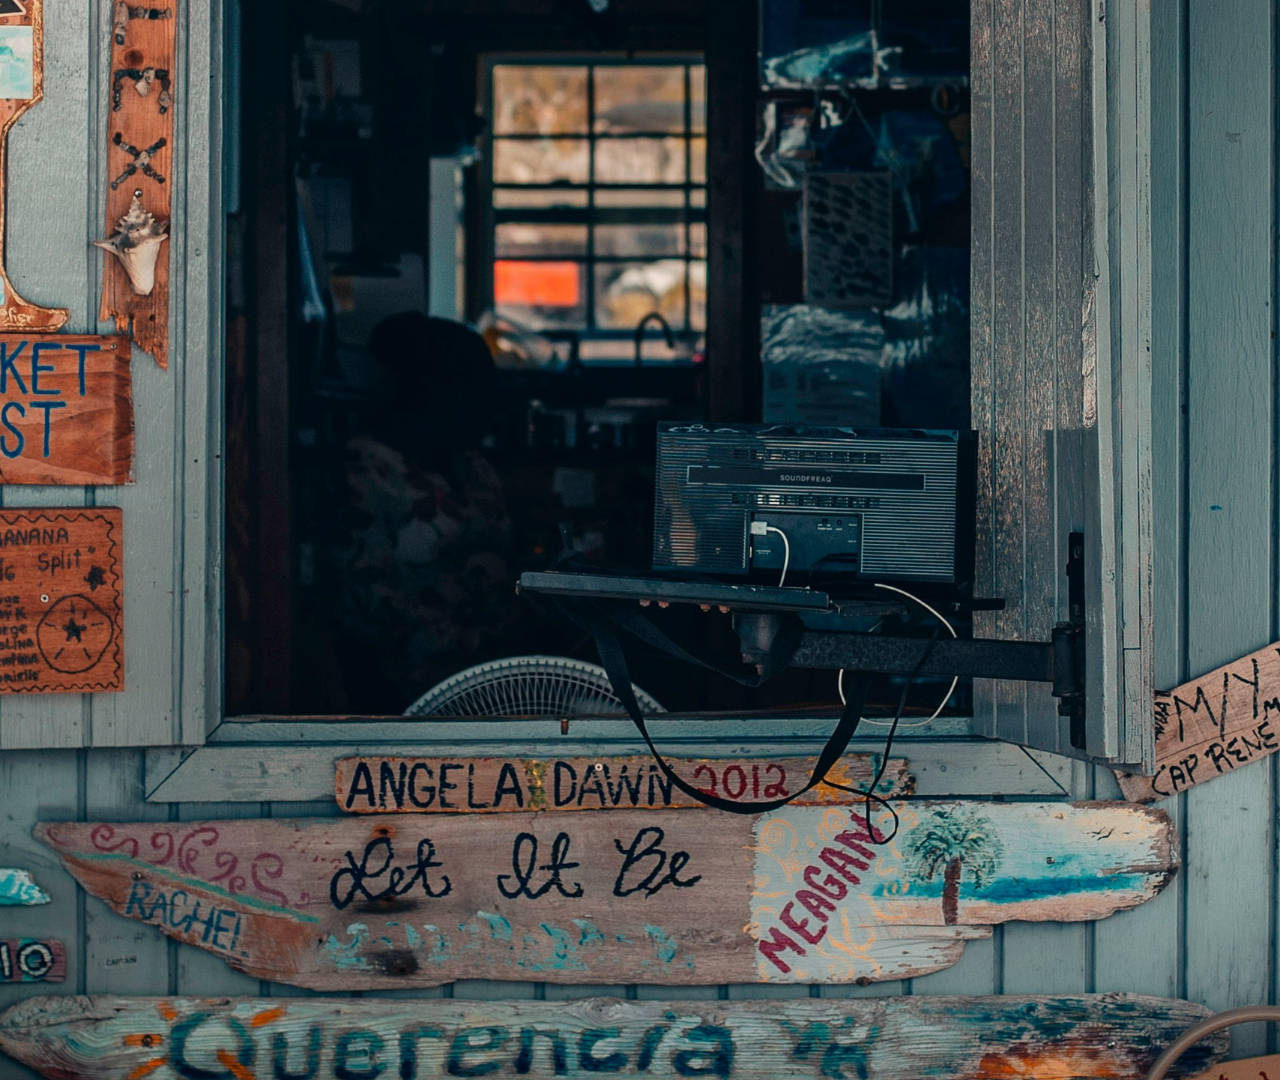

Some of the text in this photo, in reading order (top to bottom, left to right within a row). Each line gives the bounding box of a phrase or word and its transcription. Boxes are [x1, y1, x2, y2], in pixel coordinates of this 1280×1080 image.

[345, 760, 792, 811] ANGELA DAWN 2012
[328, 825, 704, 911] Let It Be
[757, 808, 892, 975] MEAGAN
[124, 877, 251, 960] RACHEL
